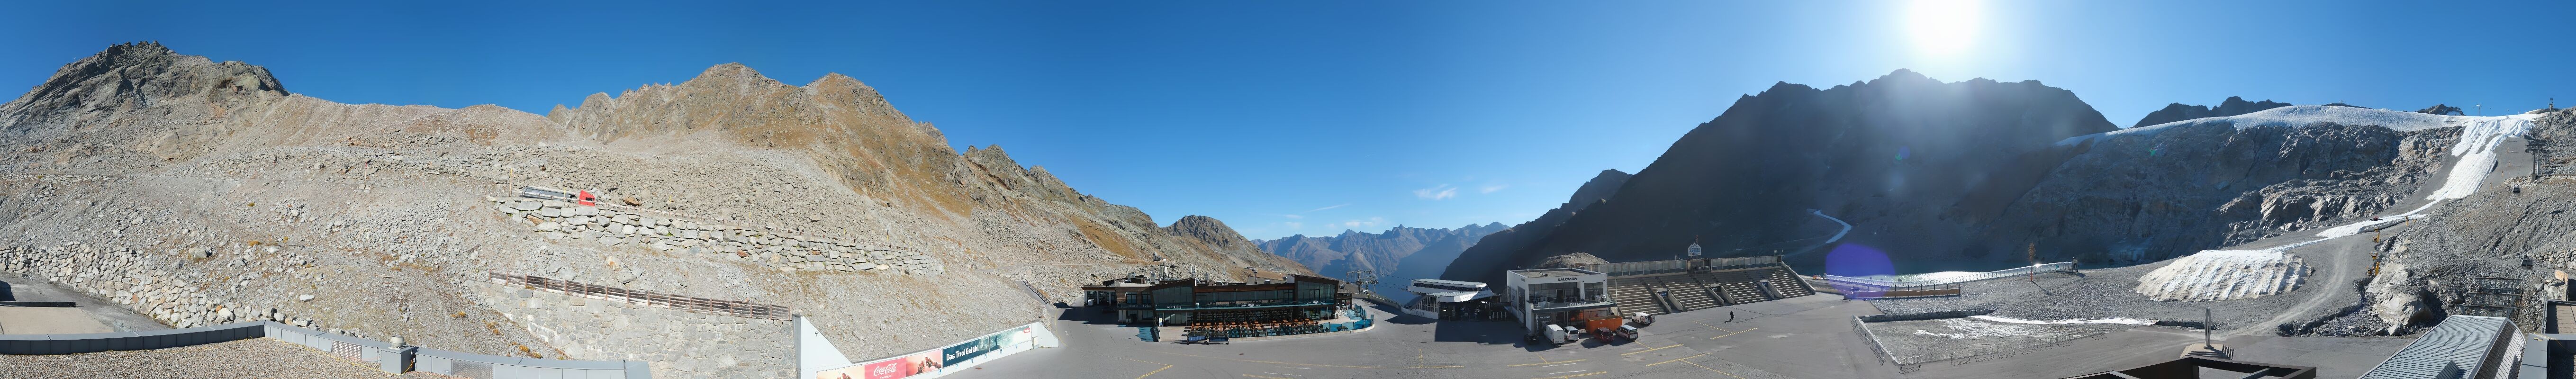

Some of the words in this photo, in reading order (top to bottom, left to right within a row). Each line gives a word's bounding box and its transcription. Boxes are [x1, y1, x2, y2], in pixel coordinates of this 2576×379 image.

[955, 349, 966, 358] Tirol
[966, 344, 979, 355] Gefühl
[874, 362, 897, 376] Coca-Cola
